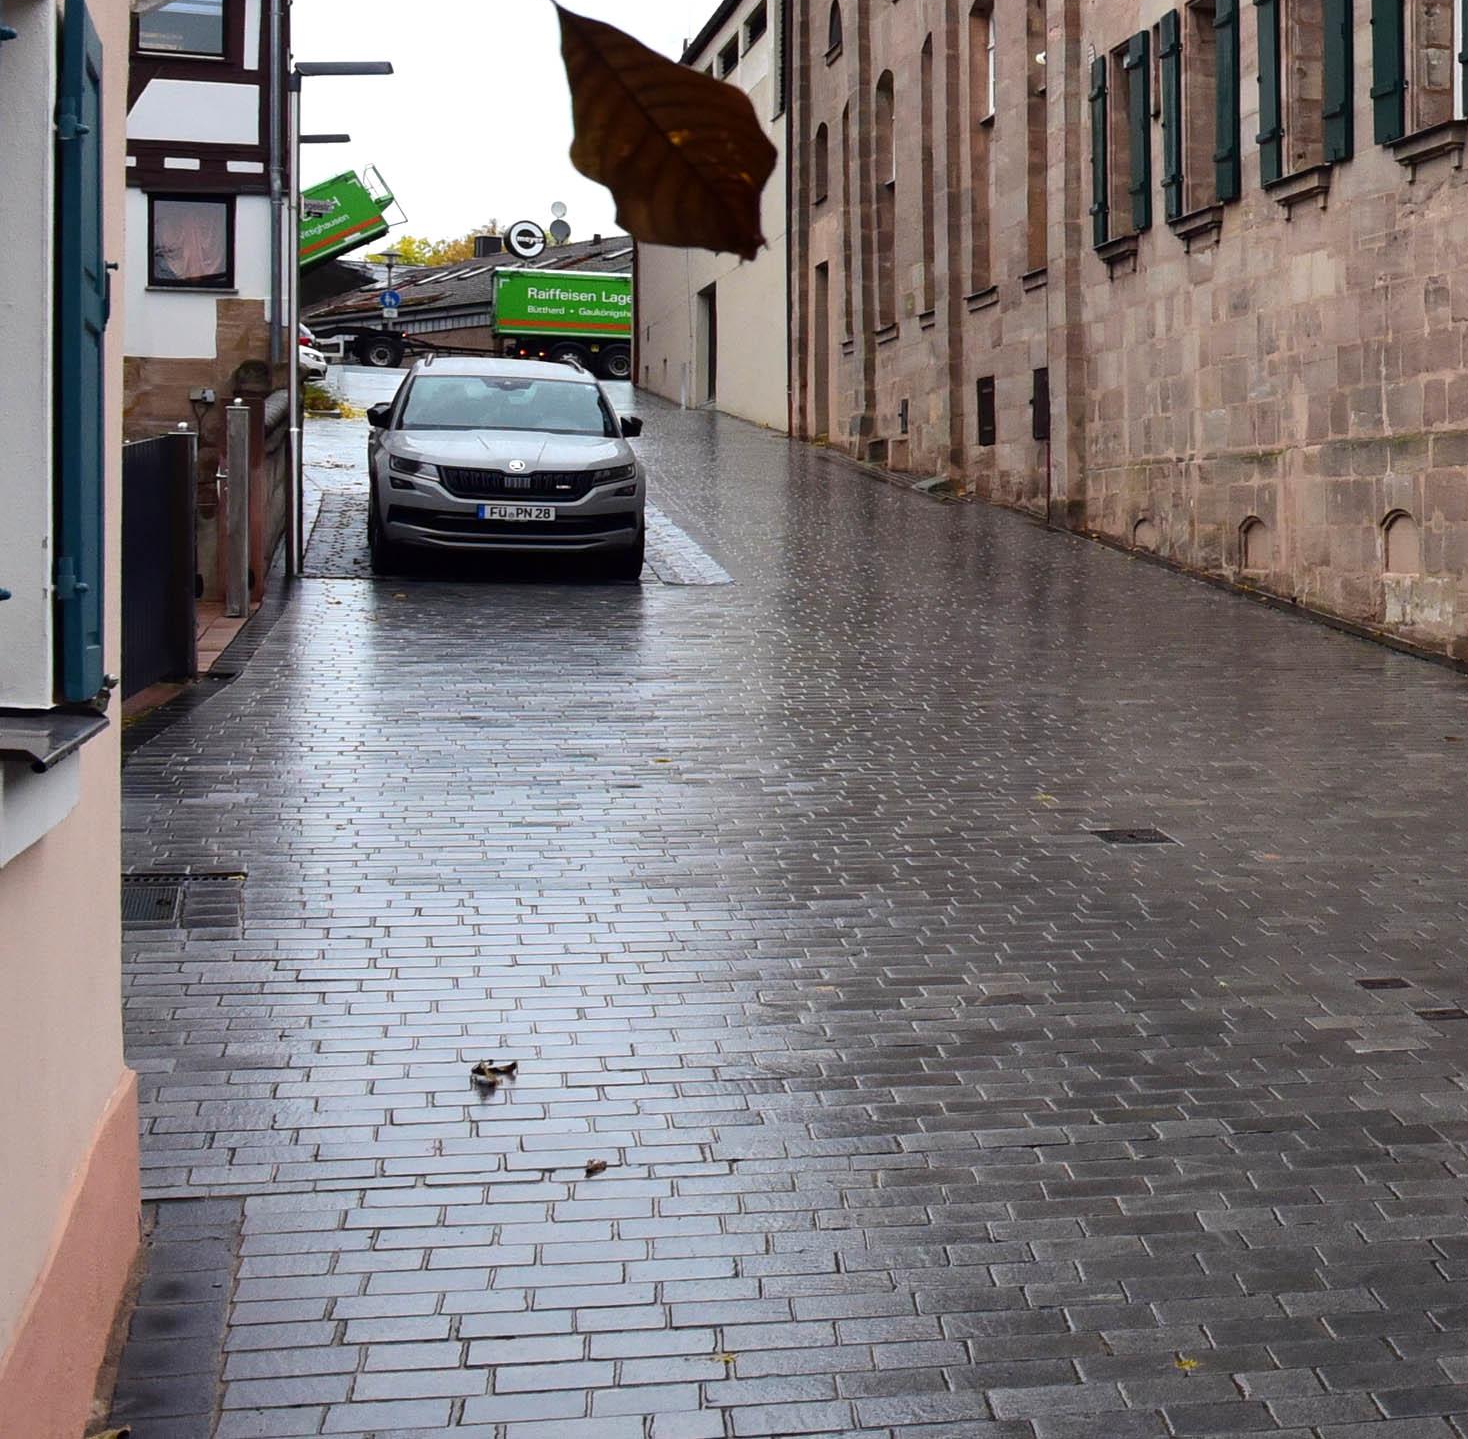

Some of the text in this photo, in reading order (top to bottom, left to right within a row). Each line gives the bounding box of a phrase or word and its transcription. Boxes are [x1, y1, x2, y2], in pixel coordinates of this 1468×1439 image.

[527, 287, 597, 302] Raiffeisen
[516, 507, 533, 519] PN
[535, 508, 551, 519] 28
